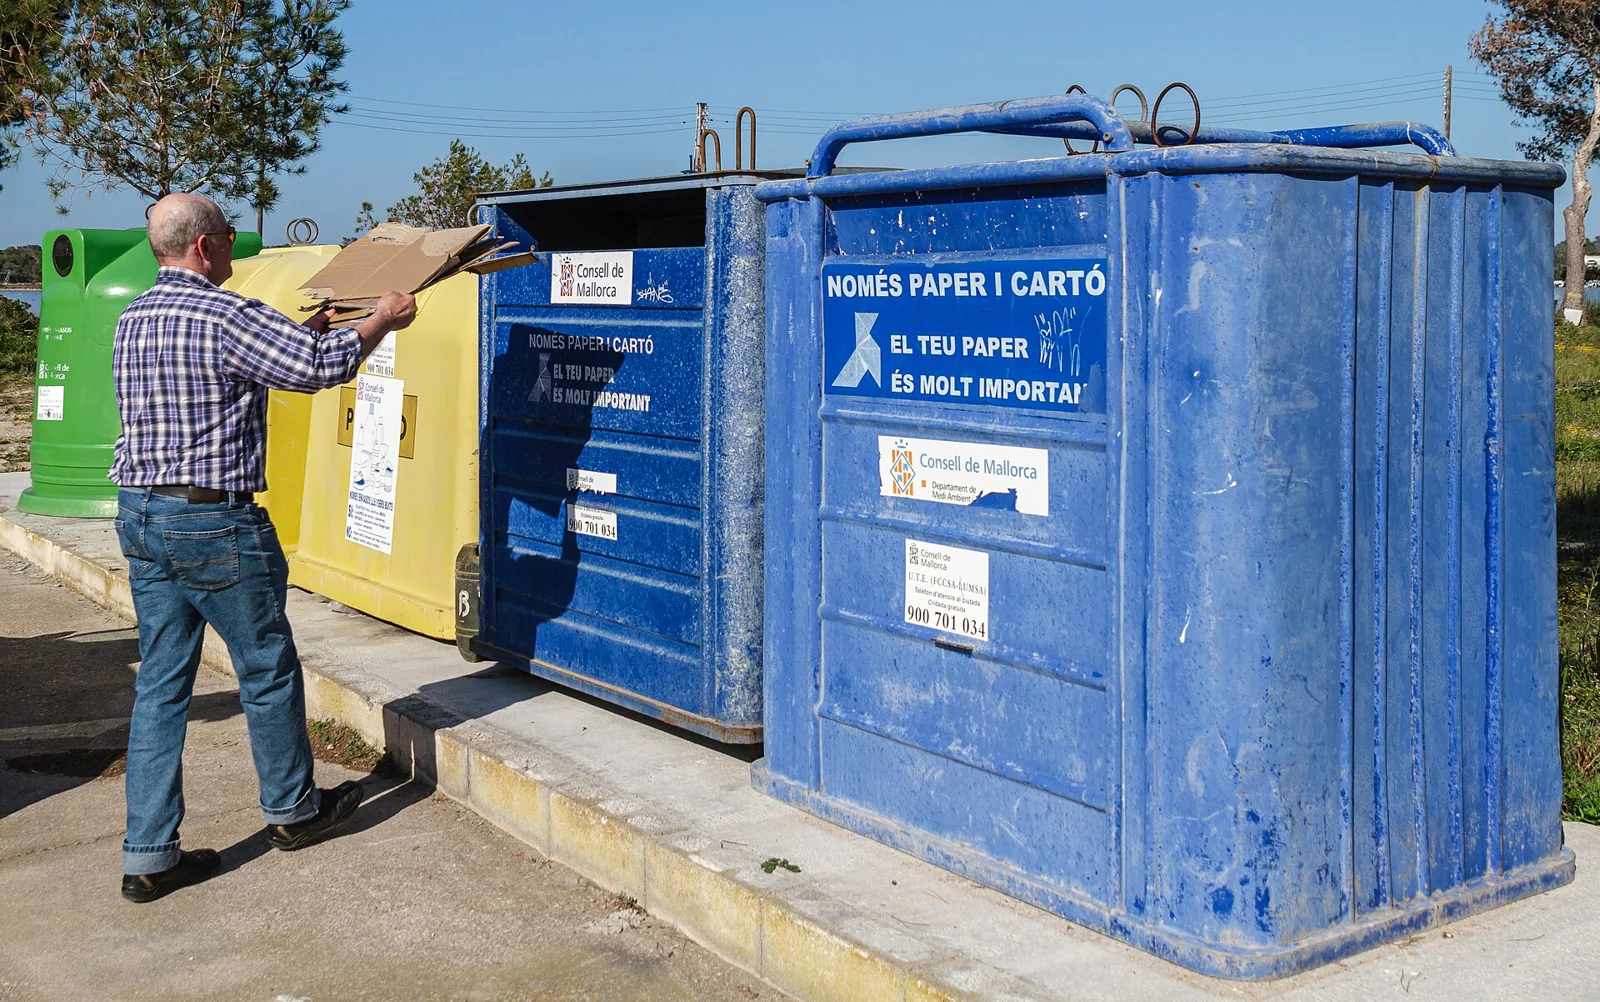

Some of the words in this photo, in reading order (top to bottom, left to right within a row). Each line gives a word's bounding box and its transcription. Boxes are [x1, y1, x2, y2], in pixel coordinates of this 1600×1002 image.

[577, 263, 608, 278] Consell
[612, 263, 623, 278] de
[577, 282, 616, 297] Mallorca
[828, 269, 903, 297] NOMÉS
[910, 272, 987, 297] PAPER
[995, 272, 1002, 296] I
[1011, 264, 1106, 296] CARTÓ
[529, 331, 564, 349] NOMÉS
[568, 336, 604, 351] PAPER
[613, 335, 653, 354] CARTÓ
[890, 334, 913, 354] EL
[918, 335, 956, 356] TEU
[962, 336, 1029, 358] PAPER
[554, 364, 563, 379] EL
[566, 365, 582, 380] TEU
[585, 366, 614, 383] PAPER
[891, 369, 914, 394] ÉS
[920, 375, 972, 398] MOLT
[553, 383, 562, 403] ÉS
[565, 389, 590, 405] MOLT
[593, 391, 650, 411] IMPORTANT
[920, 453, 960, 471] Consell
[965, 457, 980, 473] de
[984, 459, 1037, 479] Mallorca
[932, 481, 968, 493] Departament
[969, 485, 976, 493] de
[932, 491, 946, 500] Medi
[948, 492, 971, 502] Ambient
[569, 519, 582, 531] 900
[585, 522, 598, 534] 701
[602, 524, 615, 538] 034
[921, 549, 942, 560] Consell
[943, 553, 951, 562] de
[921, 559, 947, 570] Mallorca
[909, 572, 928, 583] U.T.E.
[908, 605, 929, 624] 900
[935, 612, 956, 630] 701
[962, 618, 985, 637] 034
